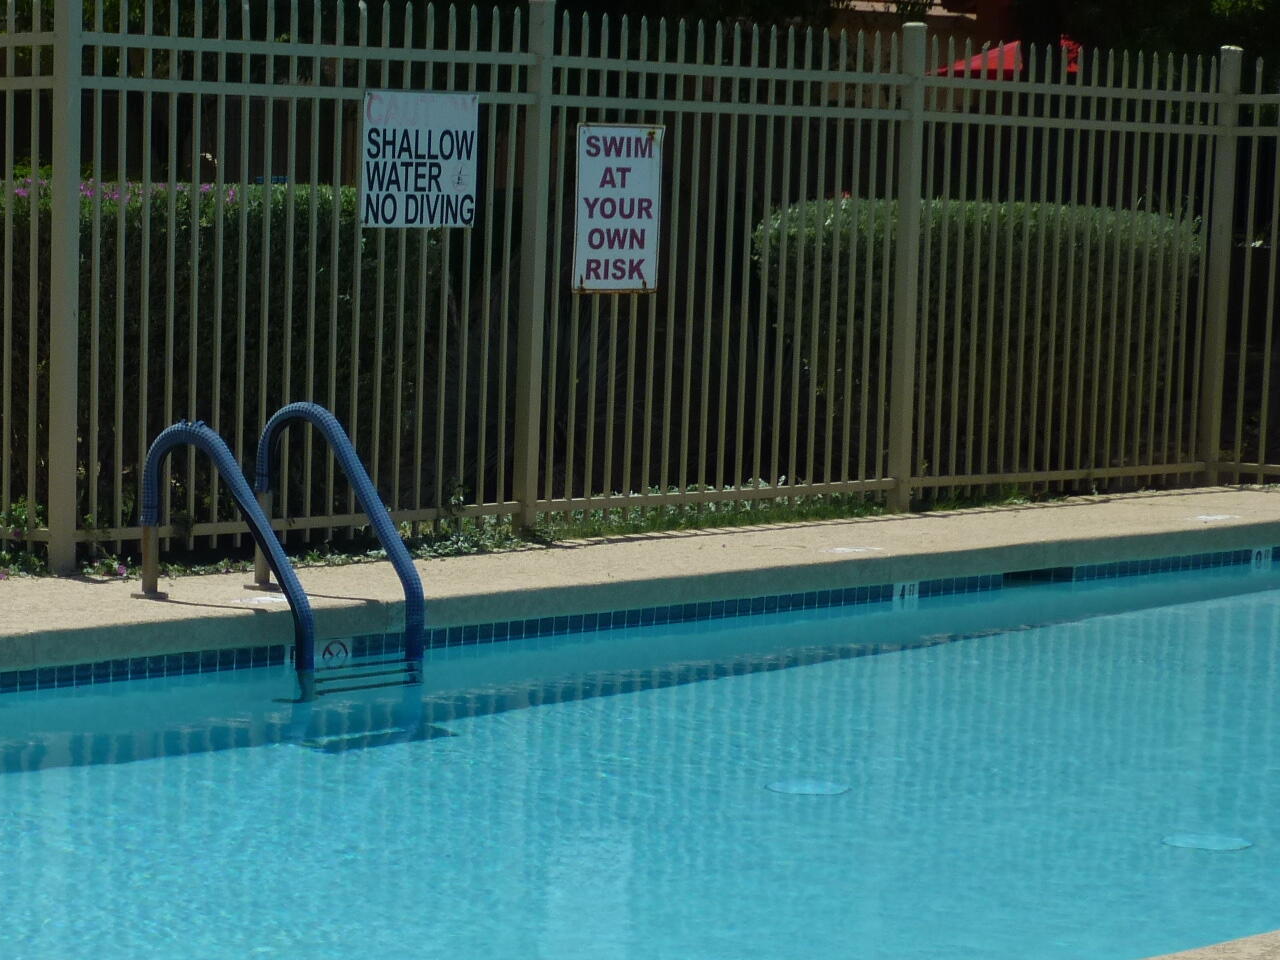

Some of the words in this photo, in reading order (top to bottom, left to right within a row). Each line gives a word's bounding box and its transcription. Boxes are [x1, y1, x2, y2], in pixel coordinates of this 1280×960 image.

[367, 127, 475, 161] SHALLOW
[585, 135, 653, 159] SWIM
[365, 161, 442, 193] WATER
[599, 166, 632, 189] AT
[364, 193, 398, 225] NO
[404, 194, 475, 225] DIVING
[583, 197, 653, 219] YOUR
[587, 227, 646, 250] OWN
[585, 258, 646, 281] RISK
